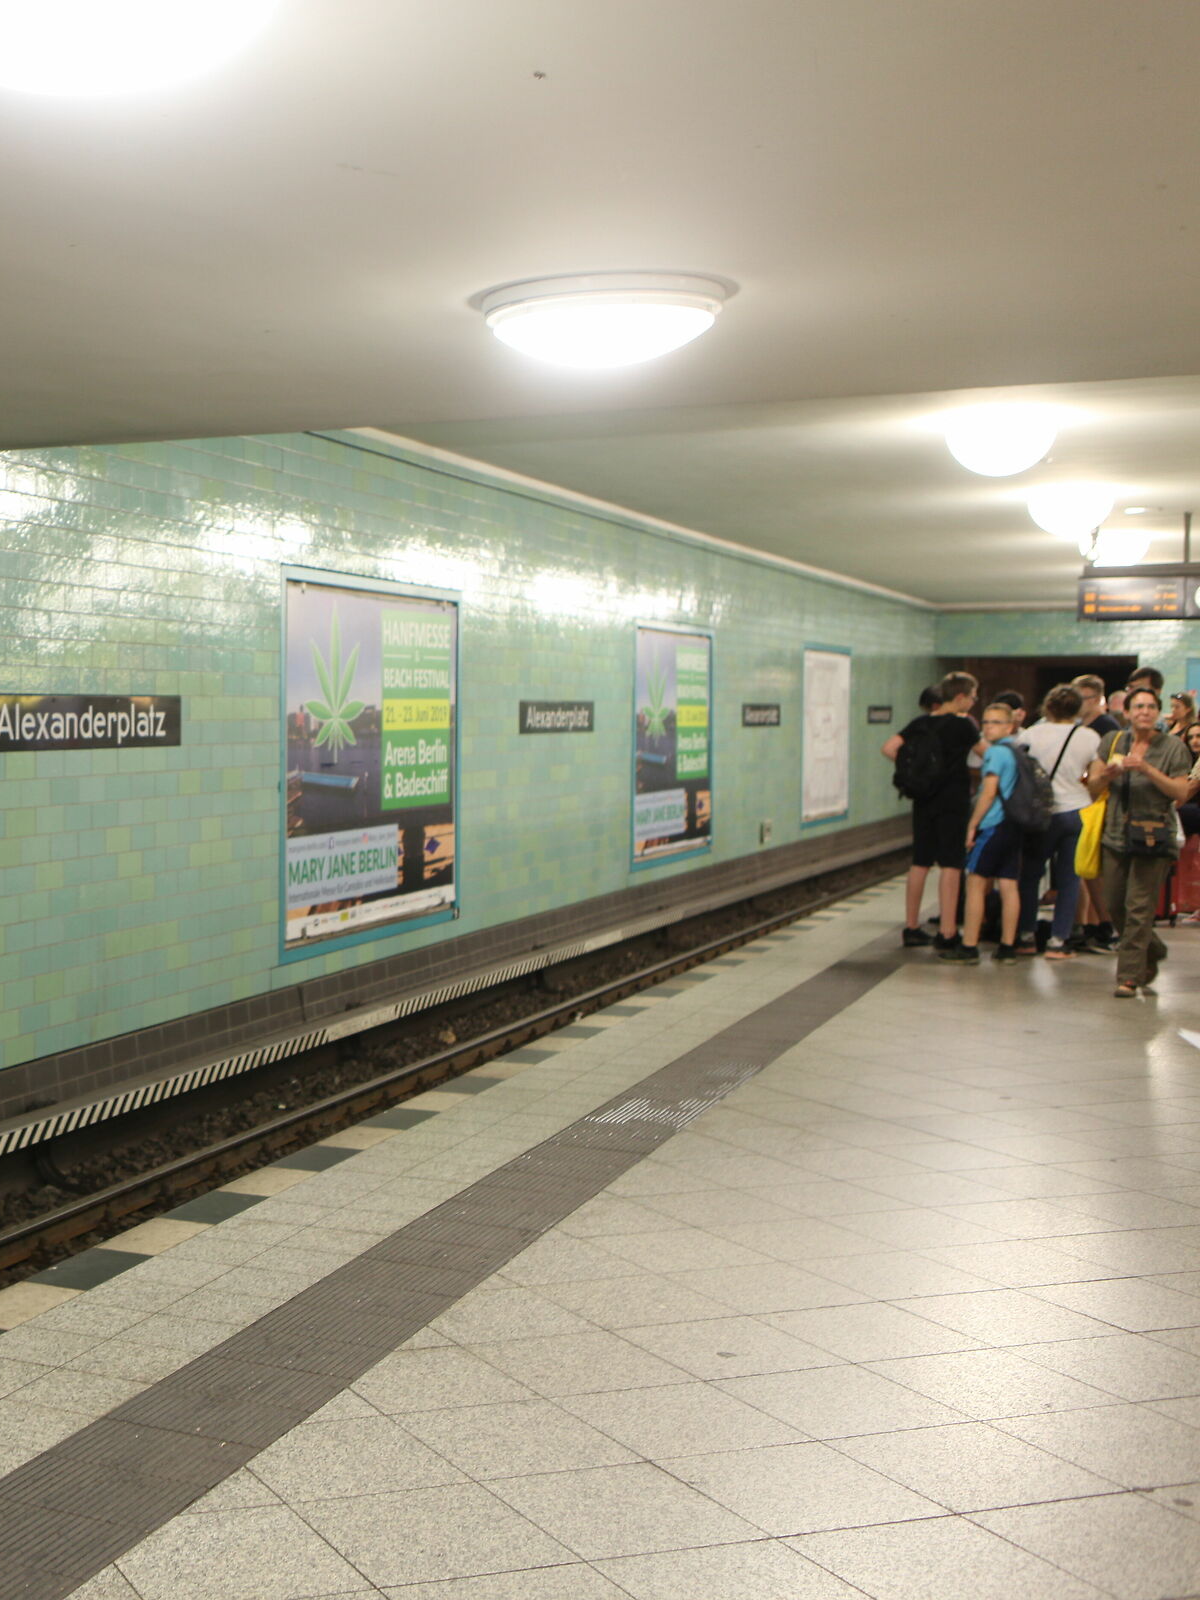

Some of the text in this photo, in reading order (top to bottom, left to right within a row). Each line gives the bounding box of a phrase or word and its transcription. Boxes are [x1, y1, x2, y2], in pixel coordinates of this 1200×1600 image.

[383, 619, 451, 648] HANFMESSE
[384, 668, 413, 688] BEACH
[525, 705, 589, 731] Alexanderplatz
[385, 738, 448, 767] Arena Berlin
[384, 768, 448, 799] & Badeschiff
[288, 847, 397, 887] MARY JANE BERLIN
